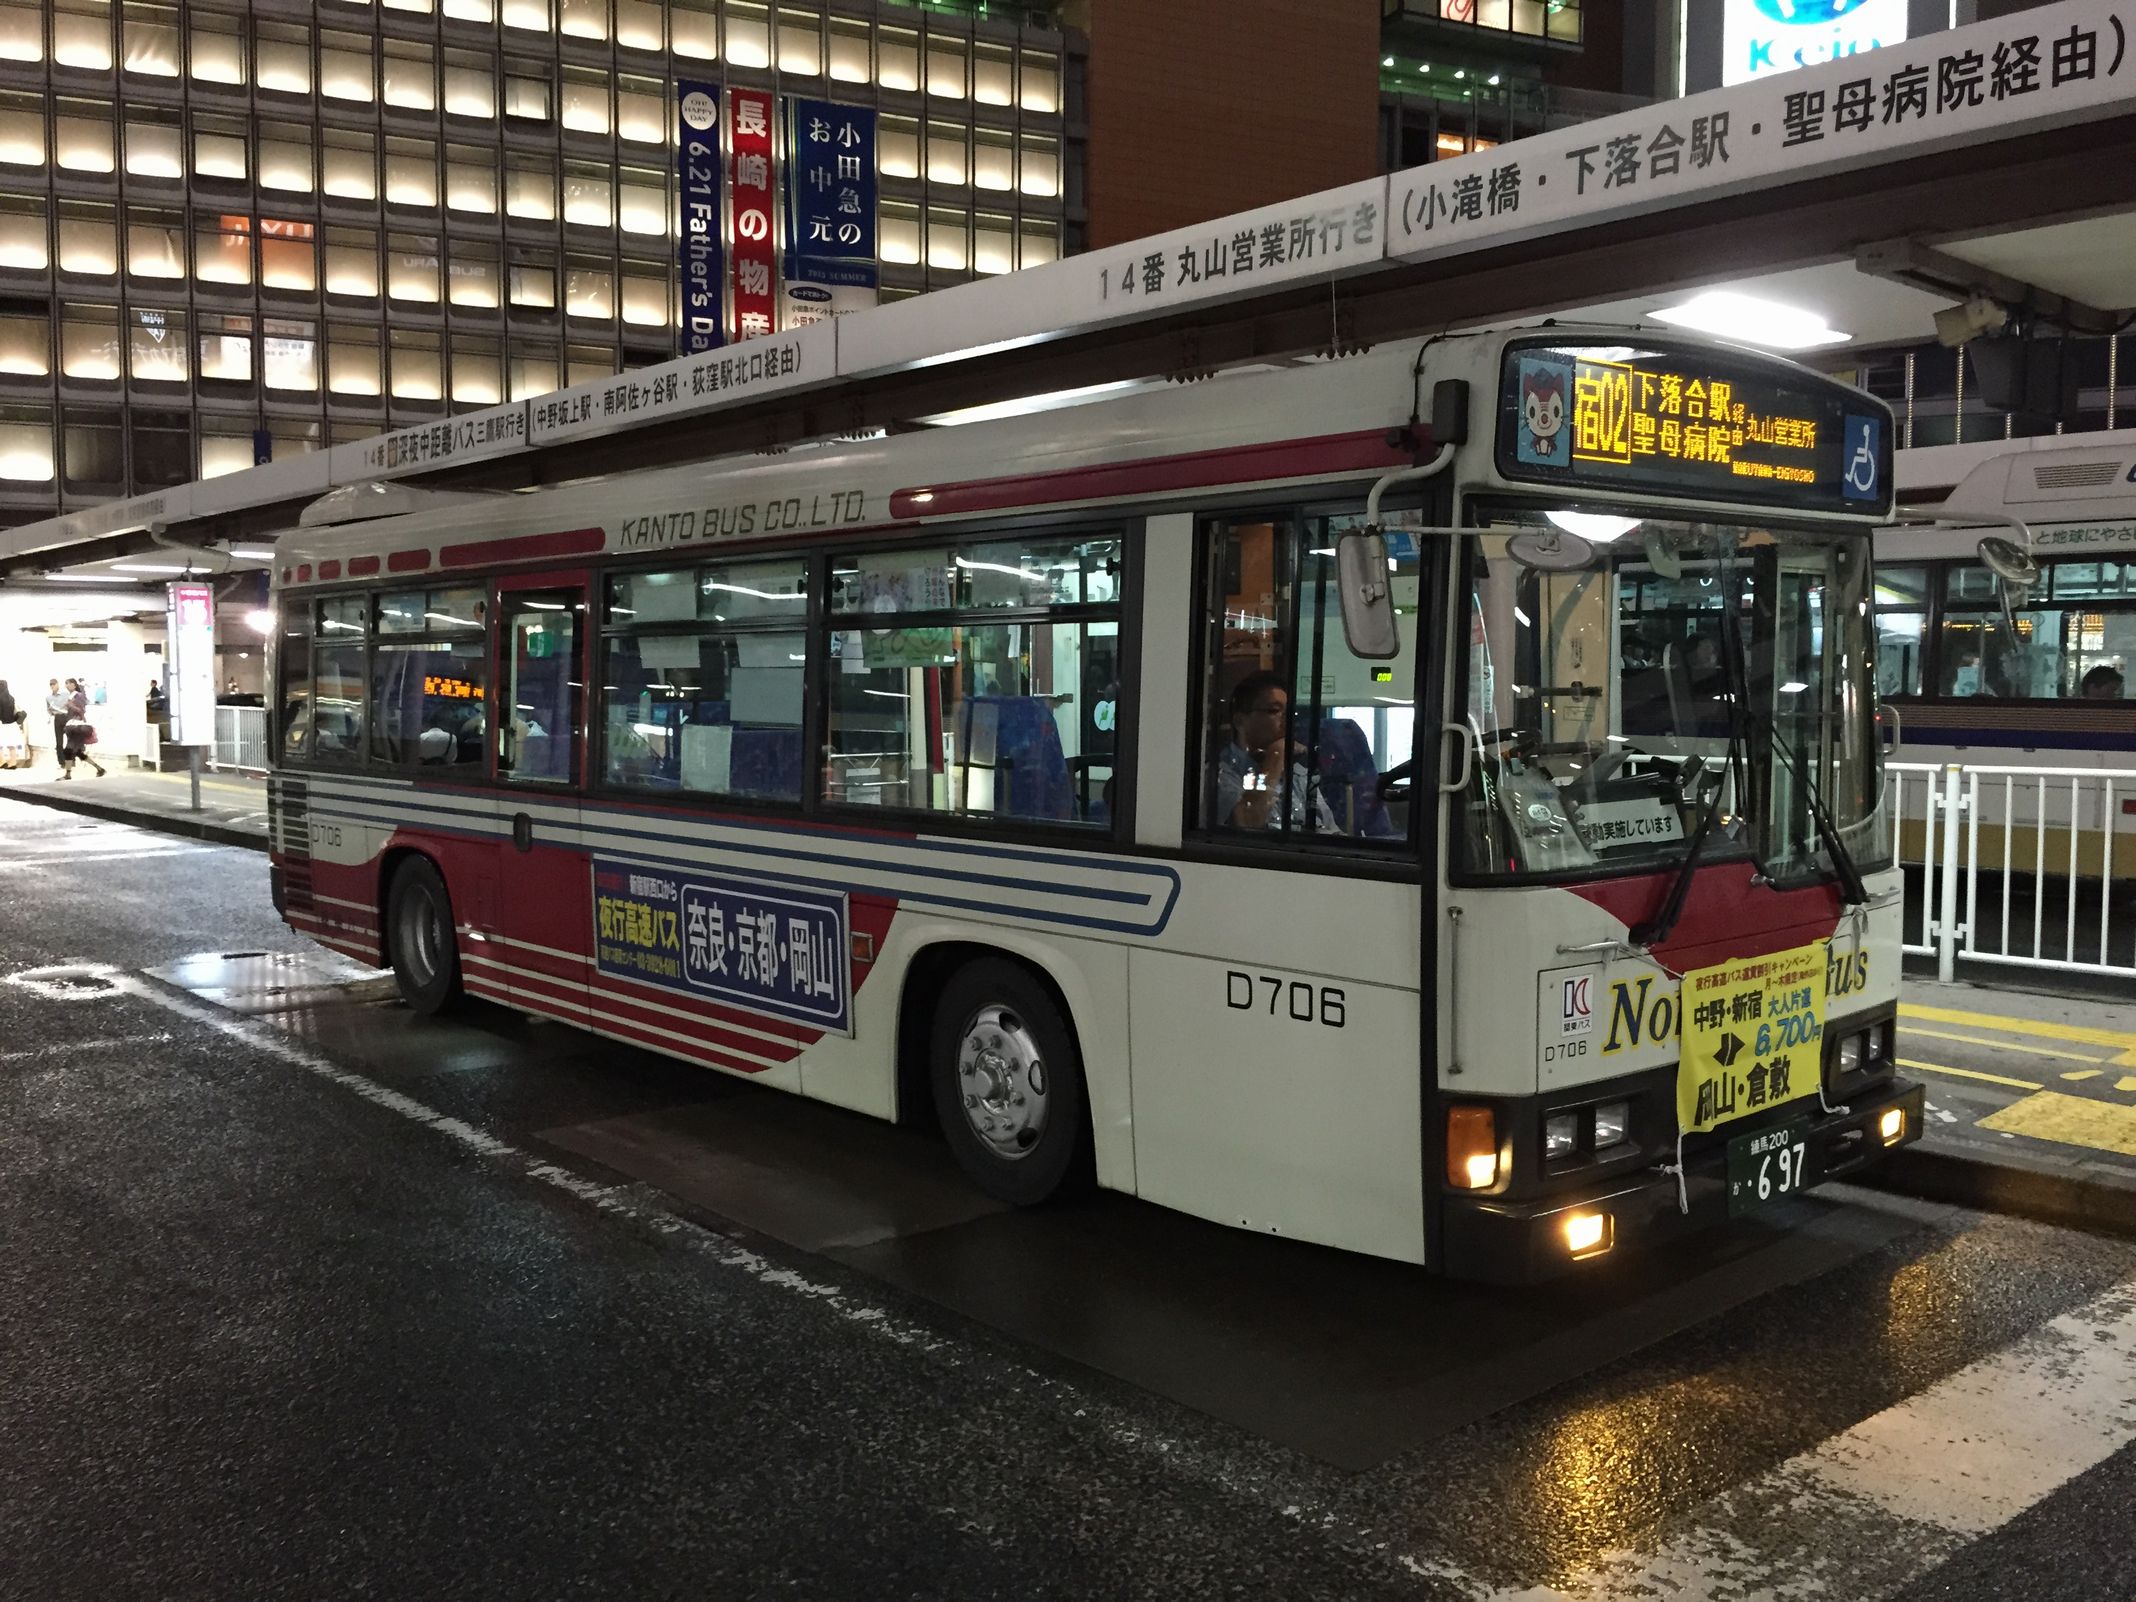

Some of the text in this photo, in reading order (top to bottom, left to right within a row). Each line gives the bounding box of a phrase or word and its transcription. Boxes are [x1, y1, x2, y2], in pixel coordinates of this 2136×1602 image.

[808, 117, 833, 242] お中元
[836, 121, 862, 245] 小田急の
[688, 142, 714, 354] 6.21 Father's Da
[1176, 201, 1379, 287] 丸山営業所行き
[1633, 371, 1731, 423] 下落合駅
[1632, 412, 1731, 464] 聖母病院
[1745, 413, 1817, 449] 丸山営業所
[620, 511, 696, 546] KANTO
[702, 503, 757, 538] BUS
[598, 894, 681, 952] 夜行高速バス
[687, 897, 835, 1001] 奈良・京都・岡山
[1226, 970, 1346, 1028] D706
[1693, 989, 1764, 1033] 中野・新宿
[1768, 986, 1812, 1018] 大人片道
[1545, 1040, 1587, 1062] D706
[1563, 1019, 1591, 1033] 関東バス
